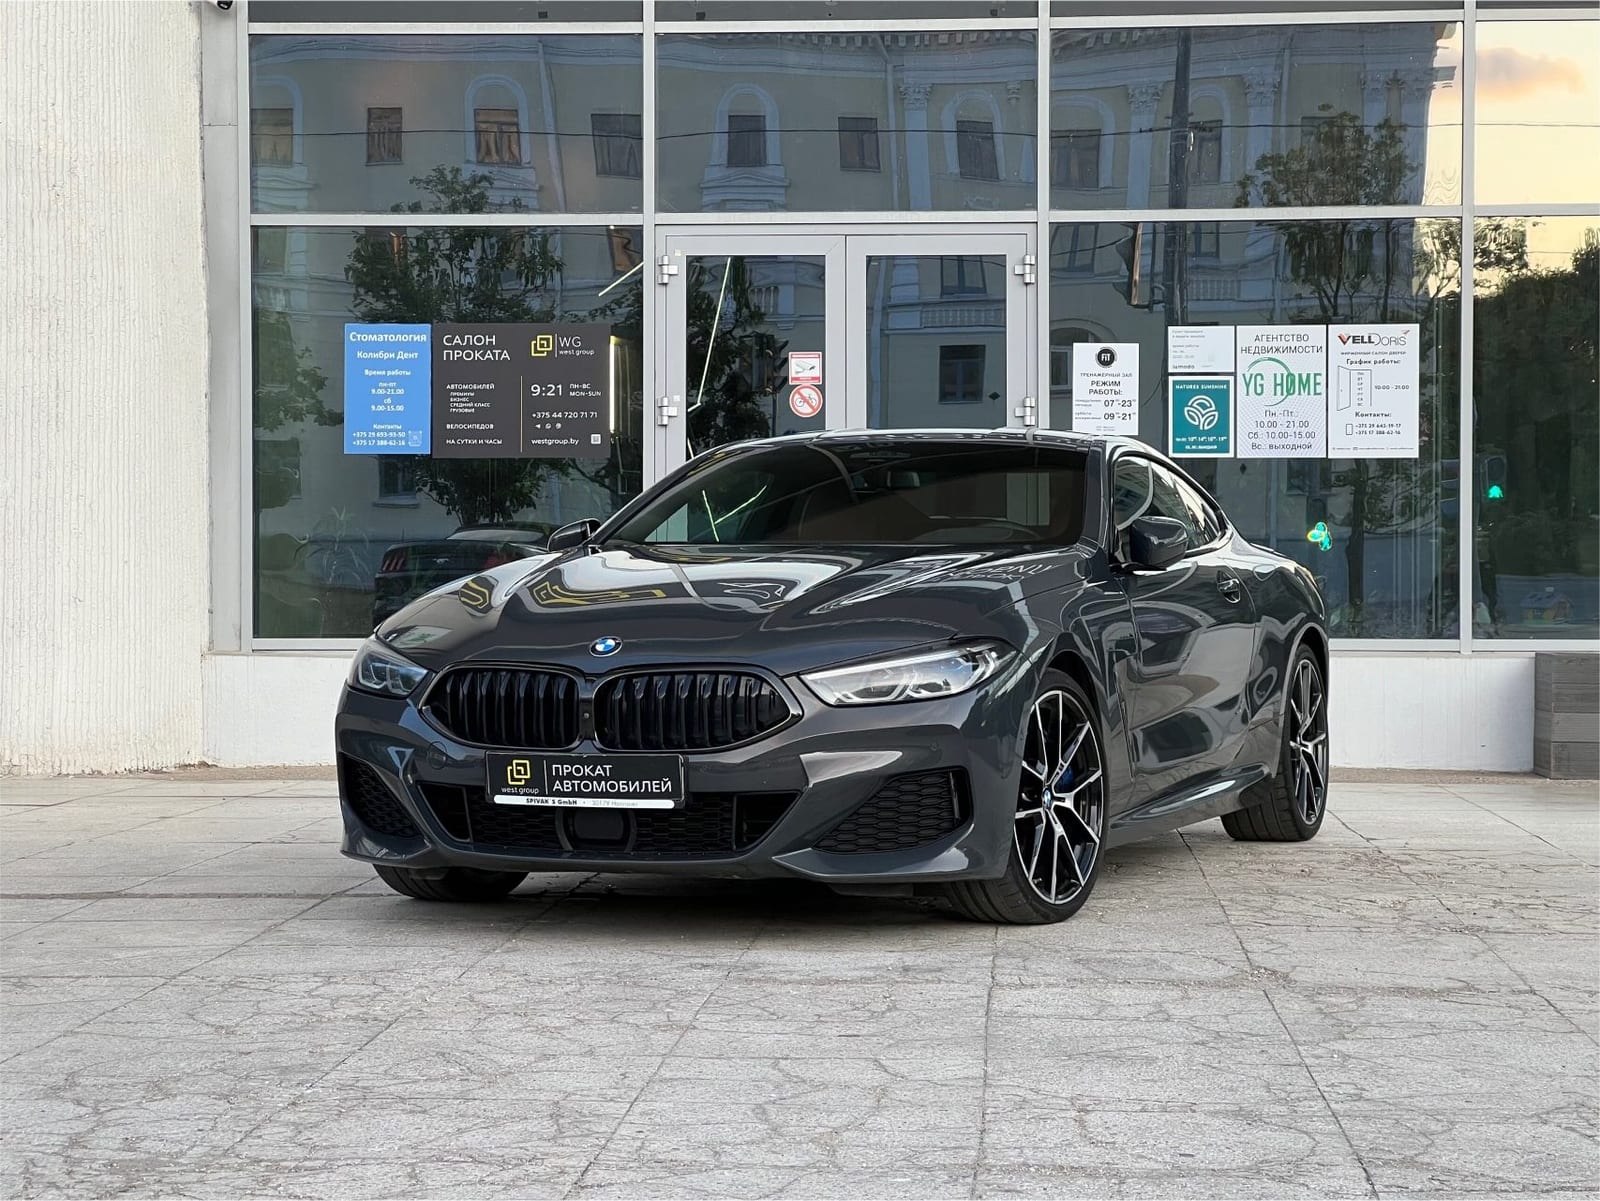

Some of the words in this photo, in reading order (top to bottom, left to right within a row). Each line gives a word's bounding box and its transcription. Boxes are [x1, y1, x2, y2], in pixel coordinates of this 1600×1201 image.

[349, 331, 427, 342] Стоматология
[442, 334, 496, 346] САЛОН
[1254, 333, 1310, 343] АГЕНТСТВО
[558, 337, 582, 348] WG
[357, 350, 395, 360] Колибри
[396, 350, 419, 360] Дент
[443, 349, 511, 361] ПРОКАТА
[1240, 345, 1323, 356] НЕДВИЖИМОСТИ
[364, 369, 386, 377] Время
[386, 369, 411, 377] работы
[1242, 372, 1265, 397] YG
[530, 384, 563, 396] 9:21
[1088, 388, 1123, 396] РАБОТЫ:
[371, 404, 405, 412] 9.00-15.00
[1255, 421, 1278, 429] 10.00
[1286, 421, 1310, 429] 21.00
[531, 438, 579, 446] westgroup.by
[1268, 442, 1313, 451] выходной
[552, 764, 612, 777] ПРОКАТ
[552, 778, 673, 793] АВТОМОБИЛЕЙ
[518, 787, 540, 795] group
